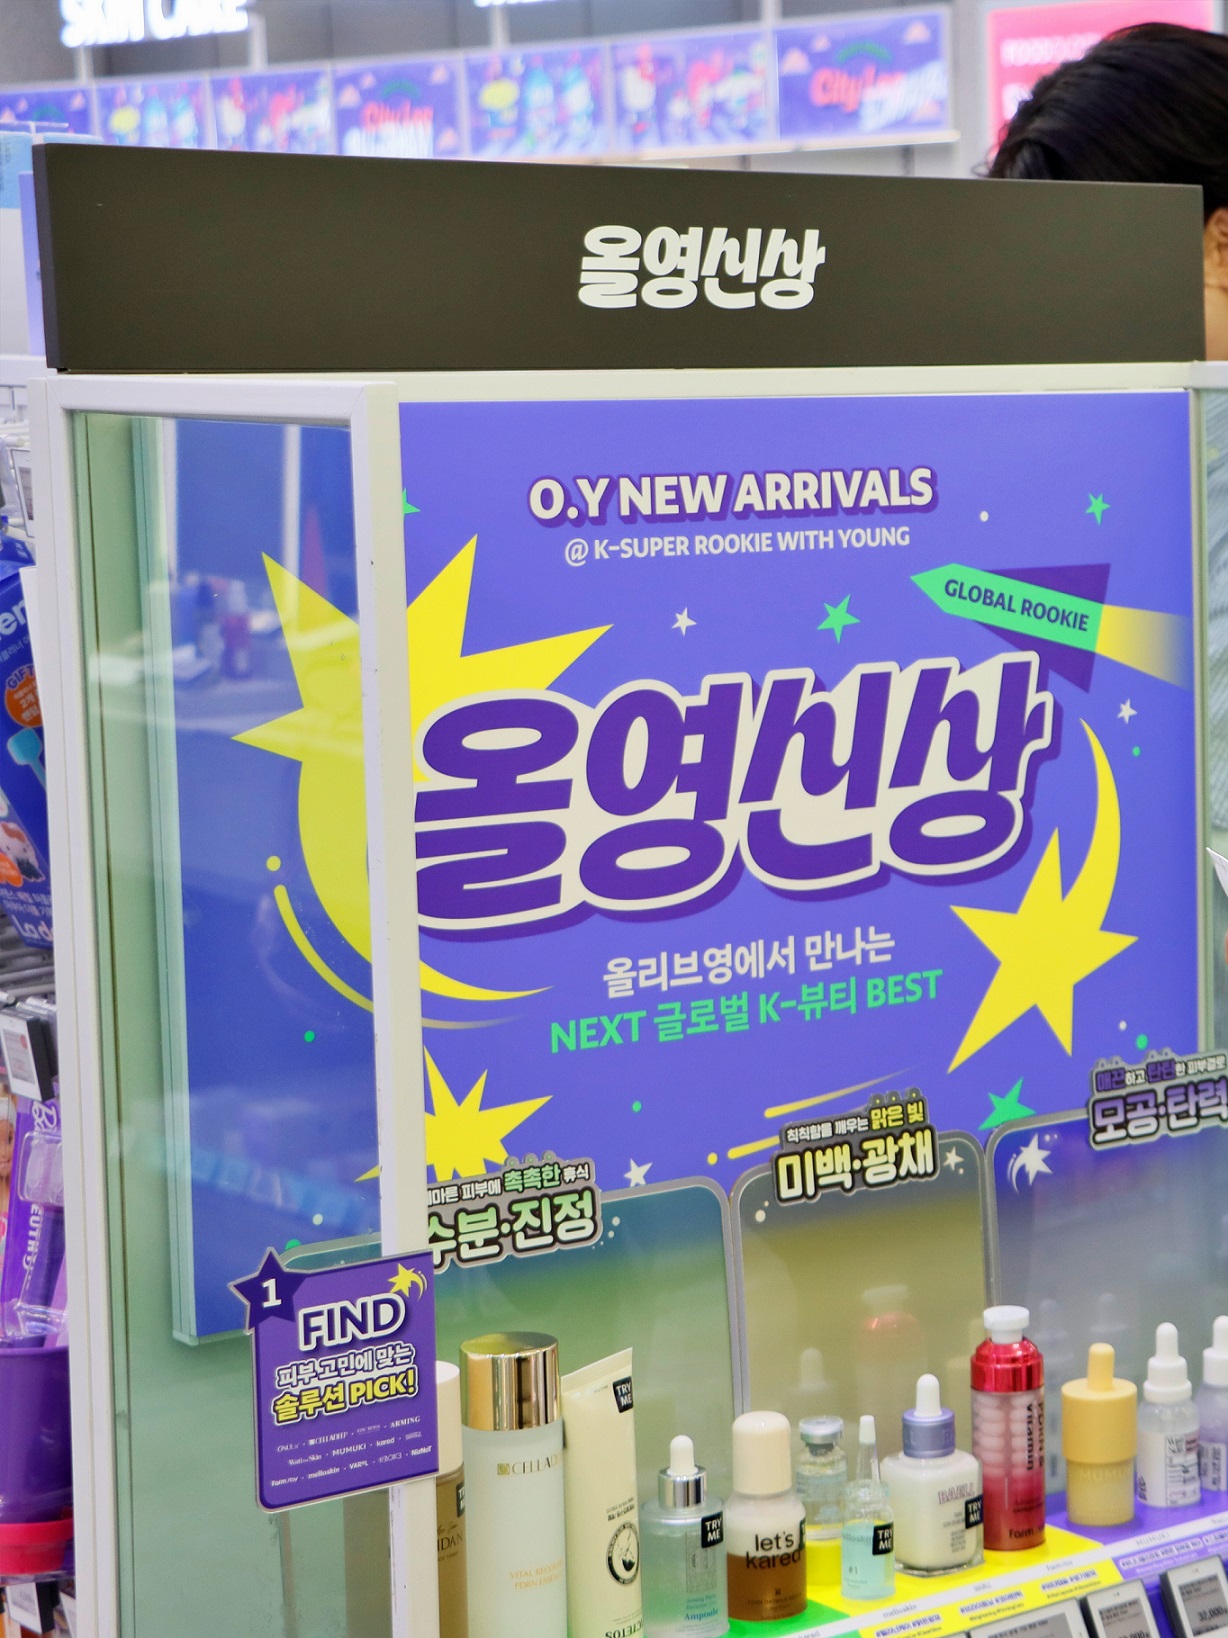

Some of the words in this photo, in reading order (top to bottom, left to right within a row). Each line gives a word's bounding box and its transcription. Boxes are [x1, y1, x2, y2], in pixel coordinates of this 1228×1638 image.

[578, 225, 826, 309] 올영신상
[529, 477, 610, 520] O.Y
[618, 473, 728, 517] NEW
[733, 467, 934, 513] ARRIVALS
[564, 538, 589, 567] @
[594, 535, 690, 560] K-SUPER
[694, 532, 773, 556] ROOKIE
[776, 529, 835, 552] WITH
[837, 526, 911, 549] YOUNG
[944, 578, 1016, 613] GLOBAL
[1020, 598, 1090, 632] ROOKIE
[414, 653, 1053, 922] 올영신상
[602, 935, 796, 999] 올리브영에서
[804, 925, 896, 972] 만나는
[550, 1010, 647, 1054] NEXT
[653, 991, 750, 1043] 글로벌
[758, 976, 858, 1024] K-뷰티
[866, 968, 944, 1009] BEST
[787, 1122, 834, 1144] 칙칙함을
[834, 1116, 869, 1136] 깨우는
[870, 1104, 904, 1131] 맑은
[906, 1100, 925, 1125] 빛
[461, 1177, 502, 1200] 피부에
[503, 1162, 561, 1193] 촉촉한
[562, 1163, 590, 1183] 휴식
[261, 1278, 282, 1308] 1
[301, 1296, 404, 1349] FIND
[376, 1344, 415, 1369] 맞는
[274, 1382, 345, 1422] 솔루션
[350, 1369, 415, 1404] PICK!
[615, 1382, 632, 1398] TRY
[620, 1394, 633, 1407] ME
[390, 1416, 421, 1429] ARMING
[332, 1443, 367, 1457] MUMUKI
[967, 1500, 982, 1514] TRY
[968, 1513, 981, 1524] ME
[704, 1517, 723, 1532] TRY
[707, 1529, 721, 1543] ME
[754, 1531, 794, 1552] let's
[746, 1550, 801, 1570] kared
